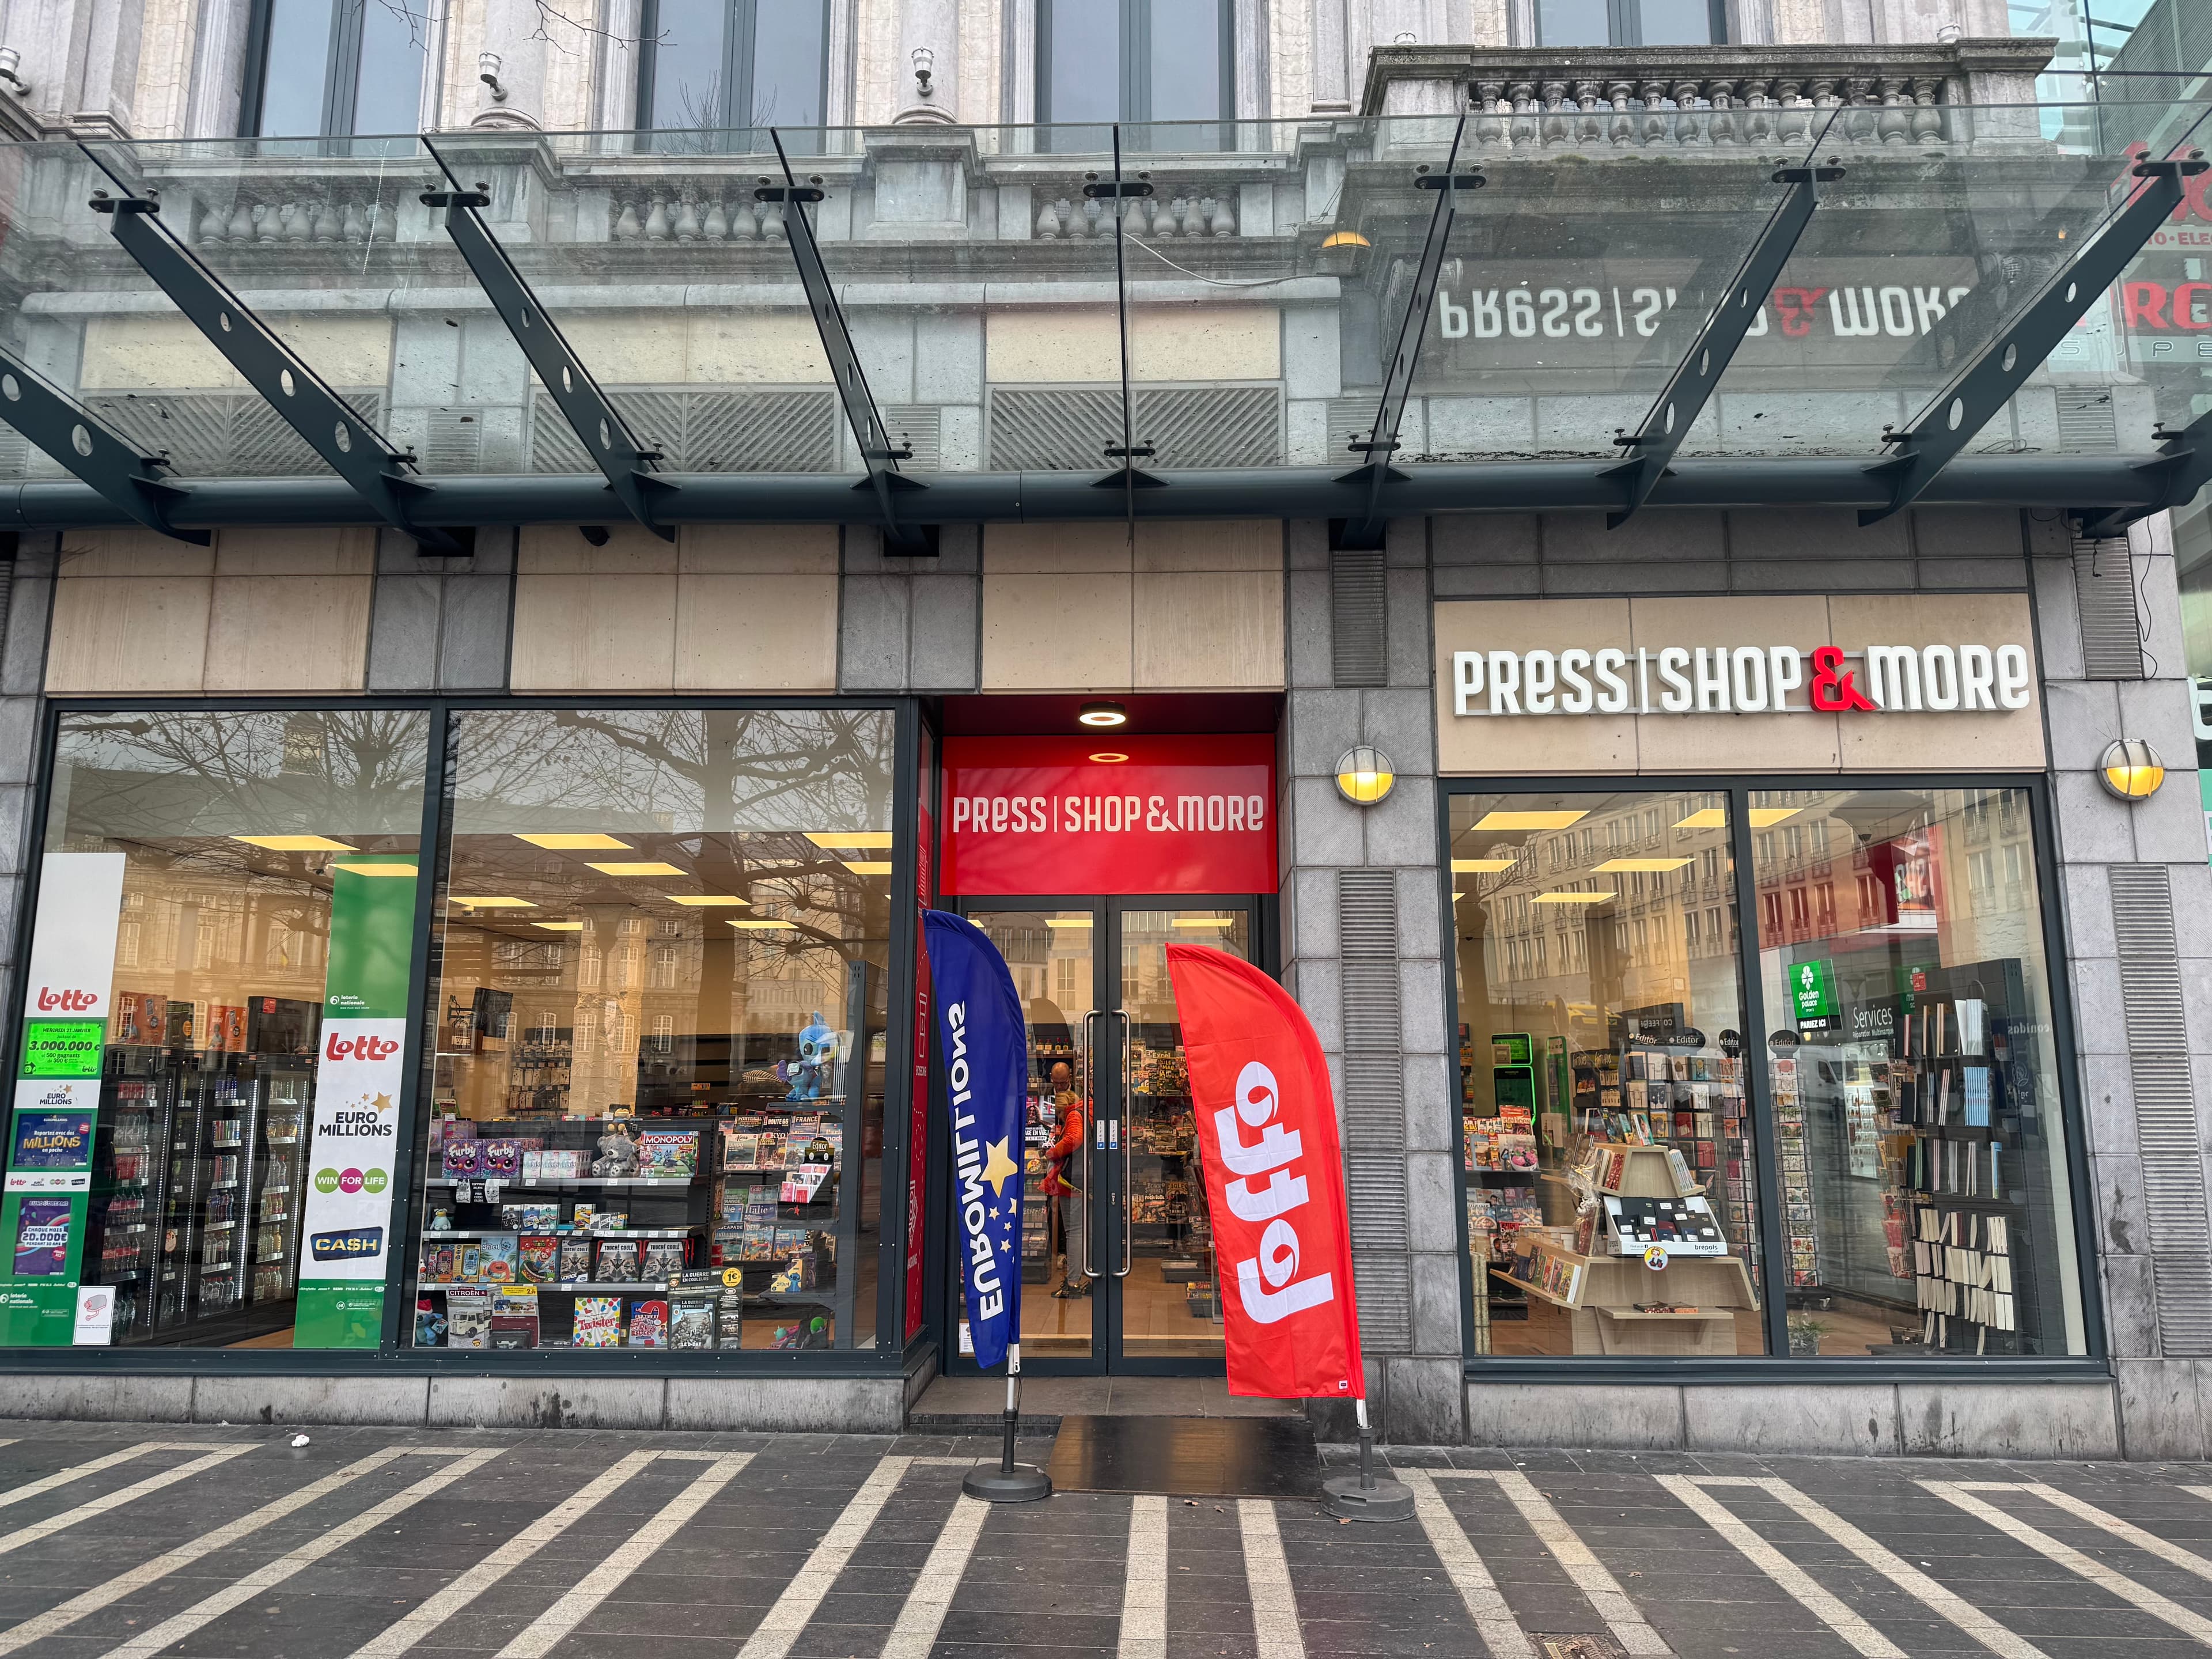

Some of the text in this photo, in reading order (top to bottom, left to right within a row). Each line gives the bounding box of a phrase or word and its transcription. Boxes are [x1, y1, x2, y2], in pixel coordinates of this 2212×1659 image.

[1453, 648, 1628, 716] PRESS
[1657, 646, 1802, 713] SHOP
[1865, 644, 2030, 712] MORE
[953, 796, 1047, 832] PRESS
[1065, 796, 1141, 832] SHOP
[1177, 795, 1263, 831] MORE
[37, 986, 98, 1011] Lotto
[1798, 990, 1819, 1001] Golden
[1853, 1005, 1893, 1029] Services
[1800, 1019, 1818, 1029] PARIEZ
[29, 1041, 93, 1051] 3.000.000
[1676, 1036, 1699, 1044] Editor
[325, 1032, 399, 1061] Lotto
[335, 1111, 378, 1124] EURO
[318, 1124, 392, 1137] MILLIONS
[22, 1135, 81, 1149] MILLIONS
[812, 1142, 827, 1150] Editor
[317, 1176, 385, 1185] WIN FOR LIFE
[745, 1205, 768, 1214] Italie
[22, 1233, 67, 1241] 20.000€
[728, 1273, 737, 1282] 1€
[578, 1317, 616, 1331] Twister
